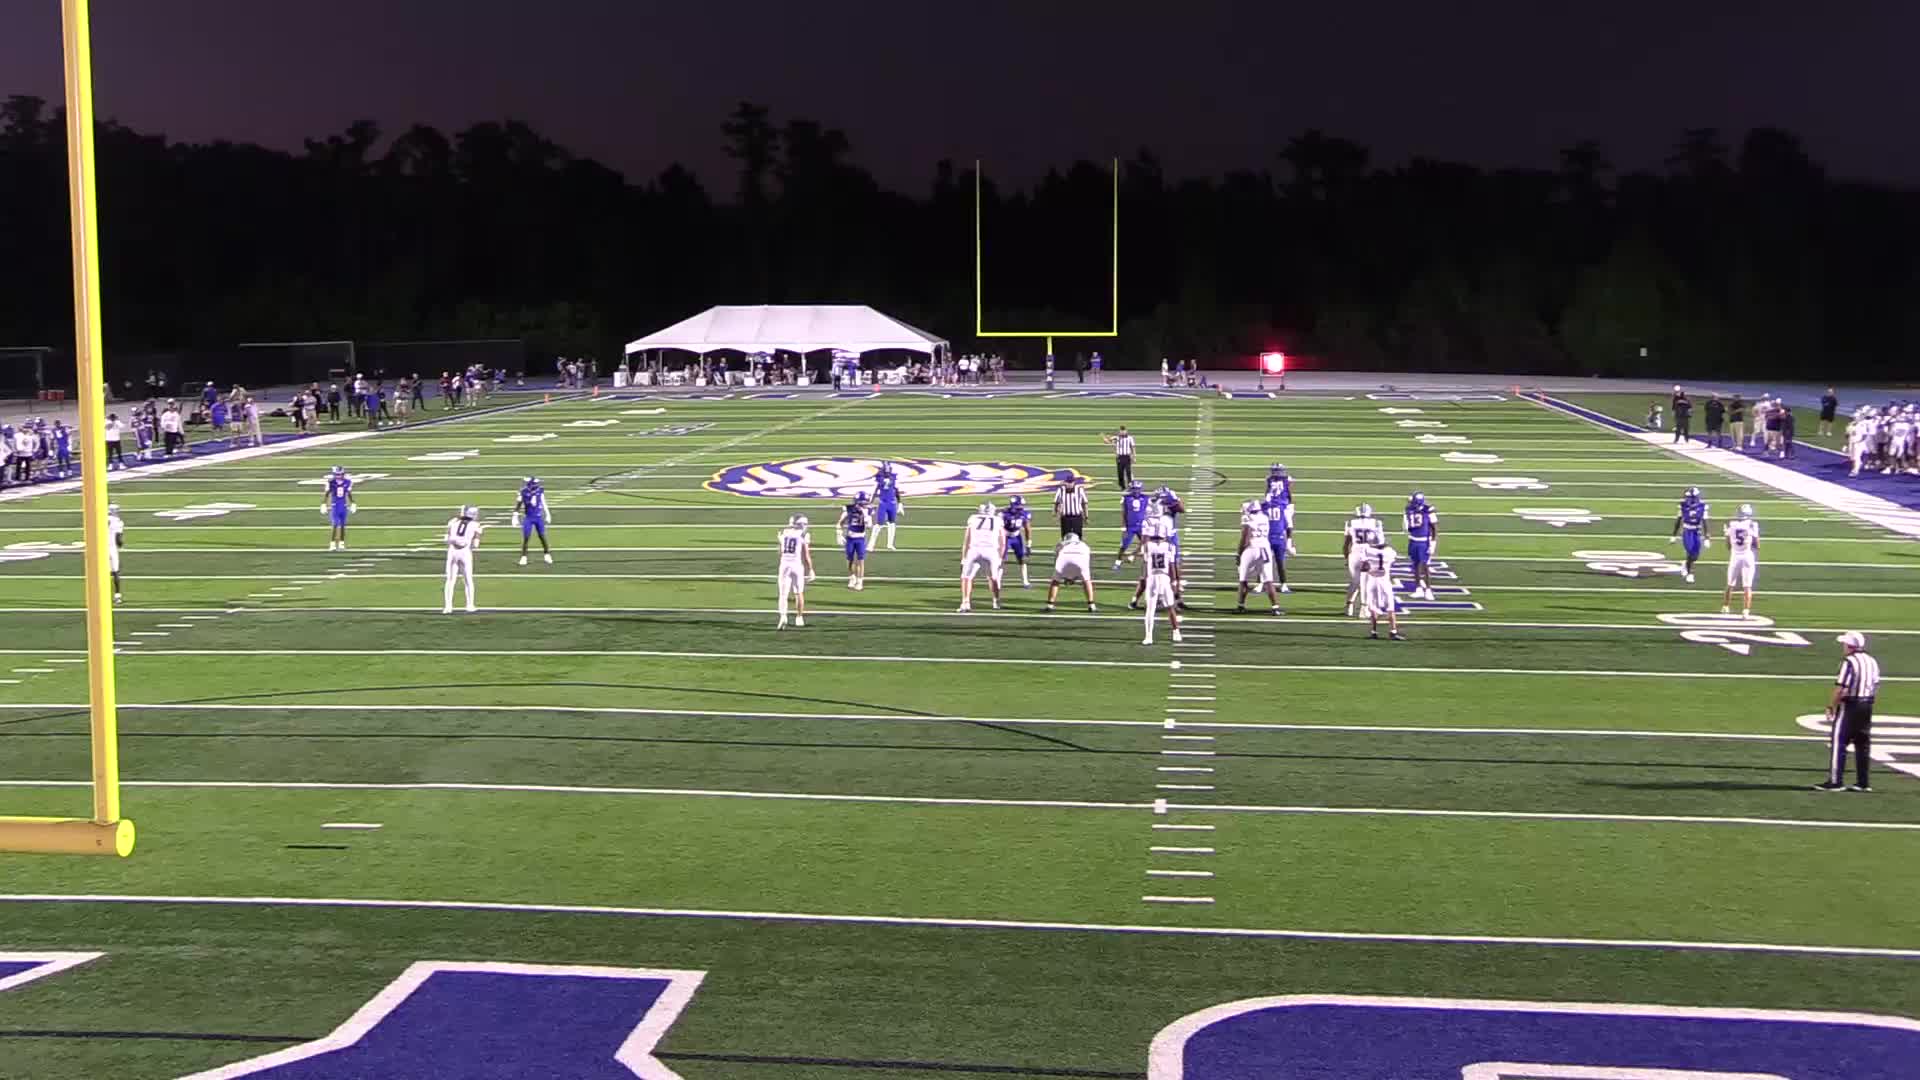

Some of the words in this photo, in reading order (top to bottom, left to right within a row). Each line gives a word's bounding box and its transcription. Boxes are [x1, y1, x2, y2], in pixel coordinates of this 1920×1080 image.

[528, 494, 538, 508] 4
[1132, 499, 1141, 512] 9
[1267, 506, 1281, 521] 10
[1409, 513, 1423, 528] 13
[456, 519, 468, 536] 0
[976, 516, 995, 532] 71
[1735, 529, 1745, 546] 5
[1151, 552, 1165, 568] 12
[1376, 553, 1384, 570] 1
